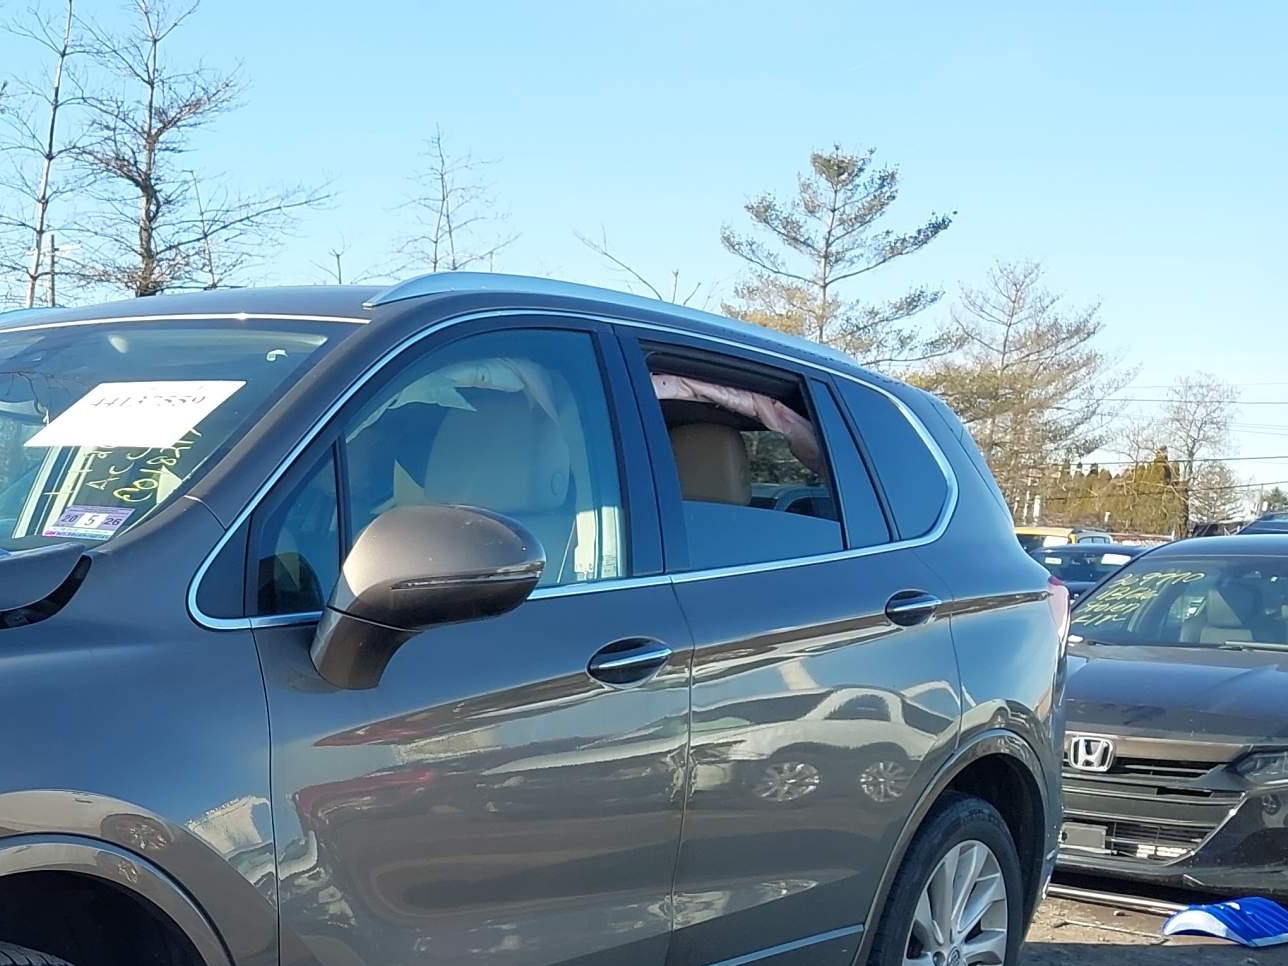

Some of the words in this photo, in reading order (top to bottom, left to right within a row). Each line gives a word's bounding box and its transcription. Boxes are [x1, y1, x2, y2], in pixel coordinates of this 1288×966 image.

[62, 514, 79, 523] 20
[83, 514, 96, 526] 5
[103, 517, 123, 526] 26
